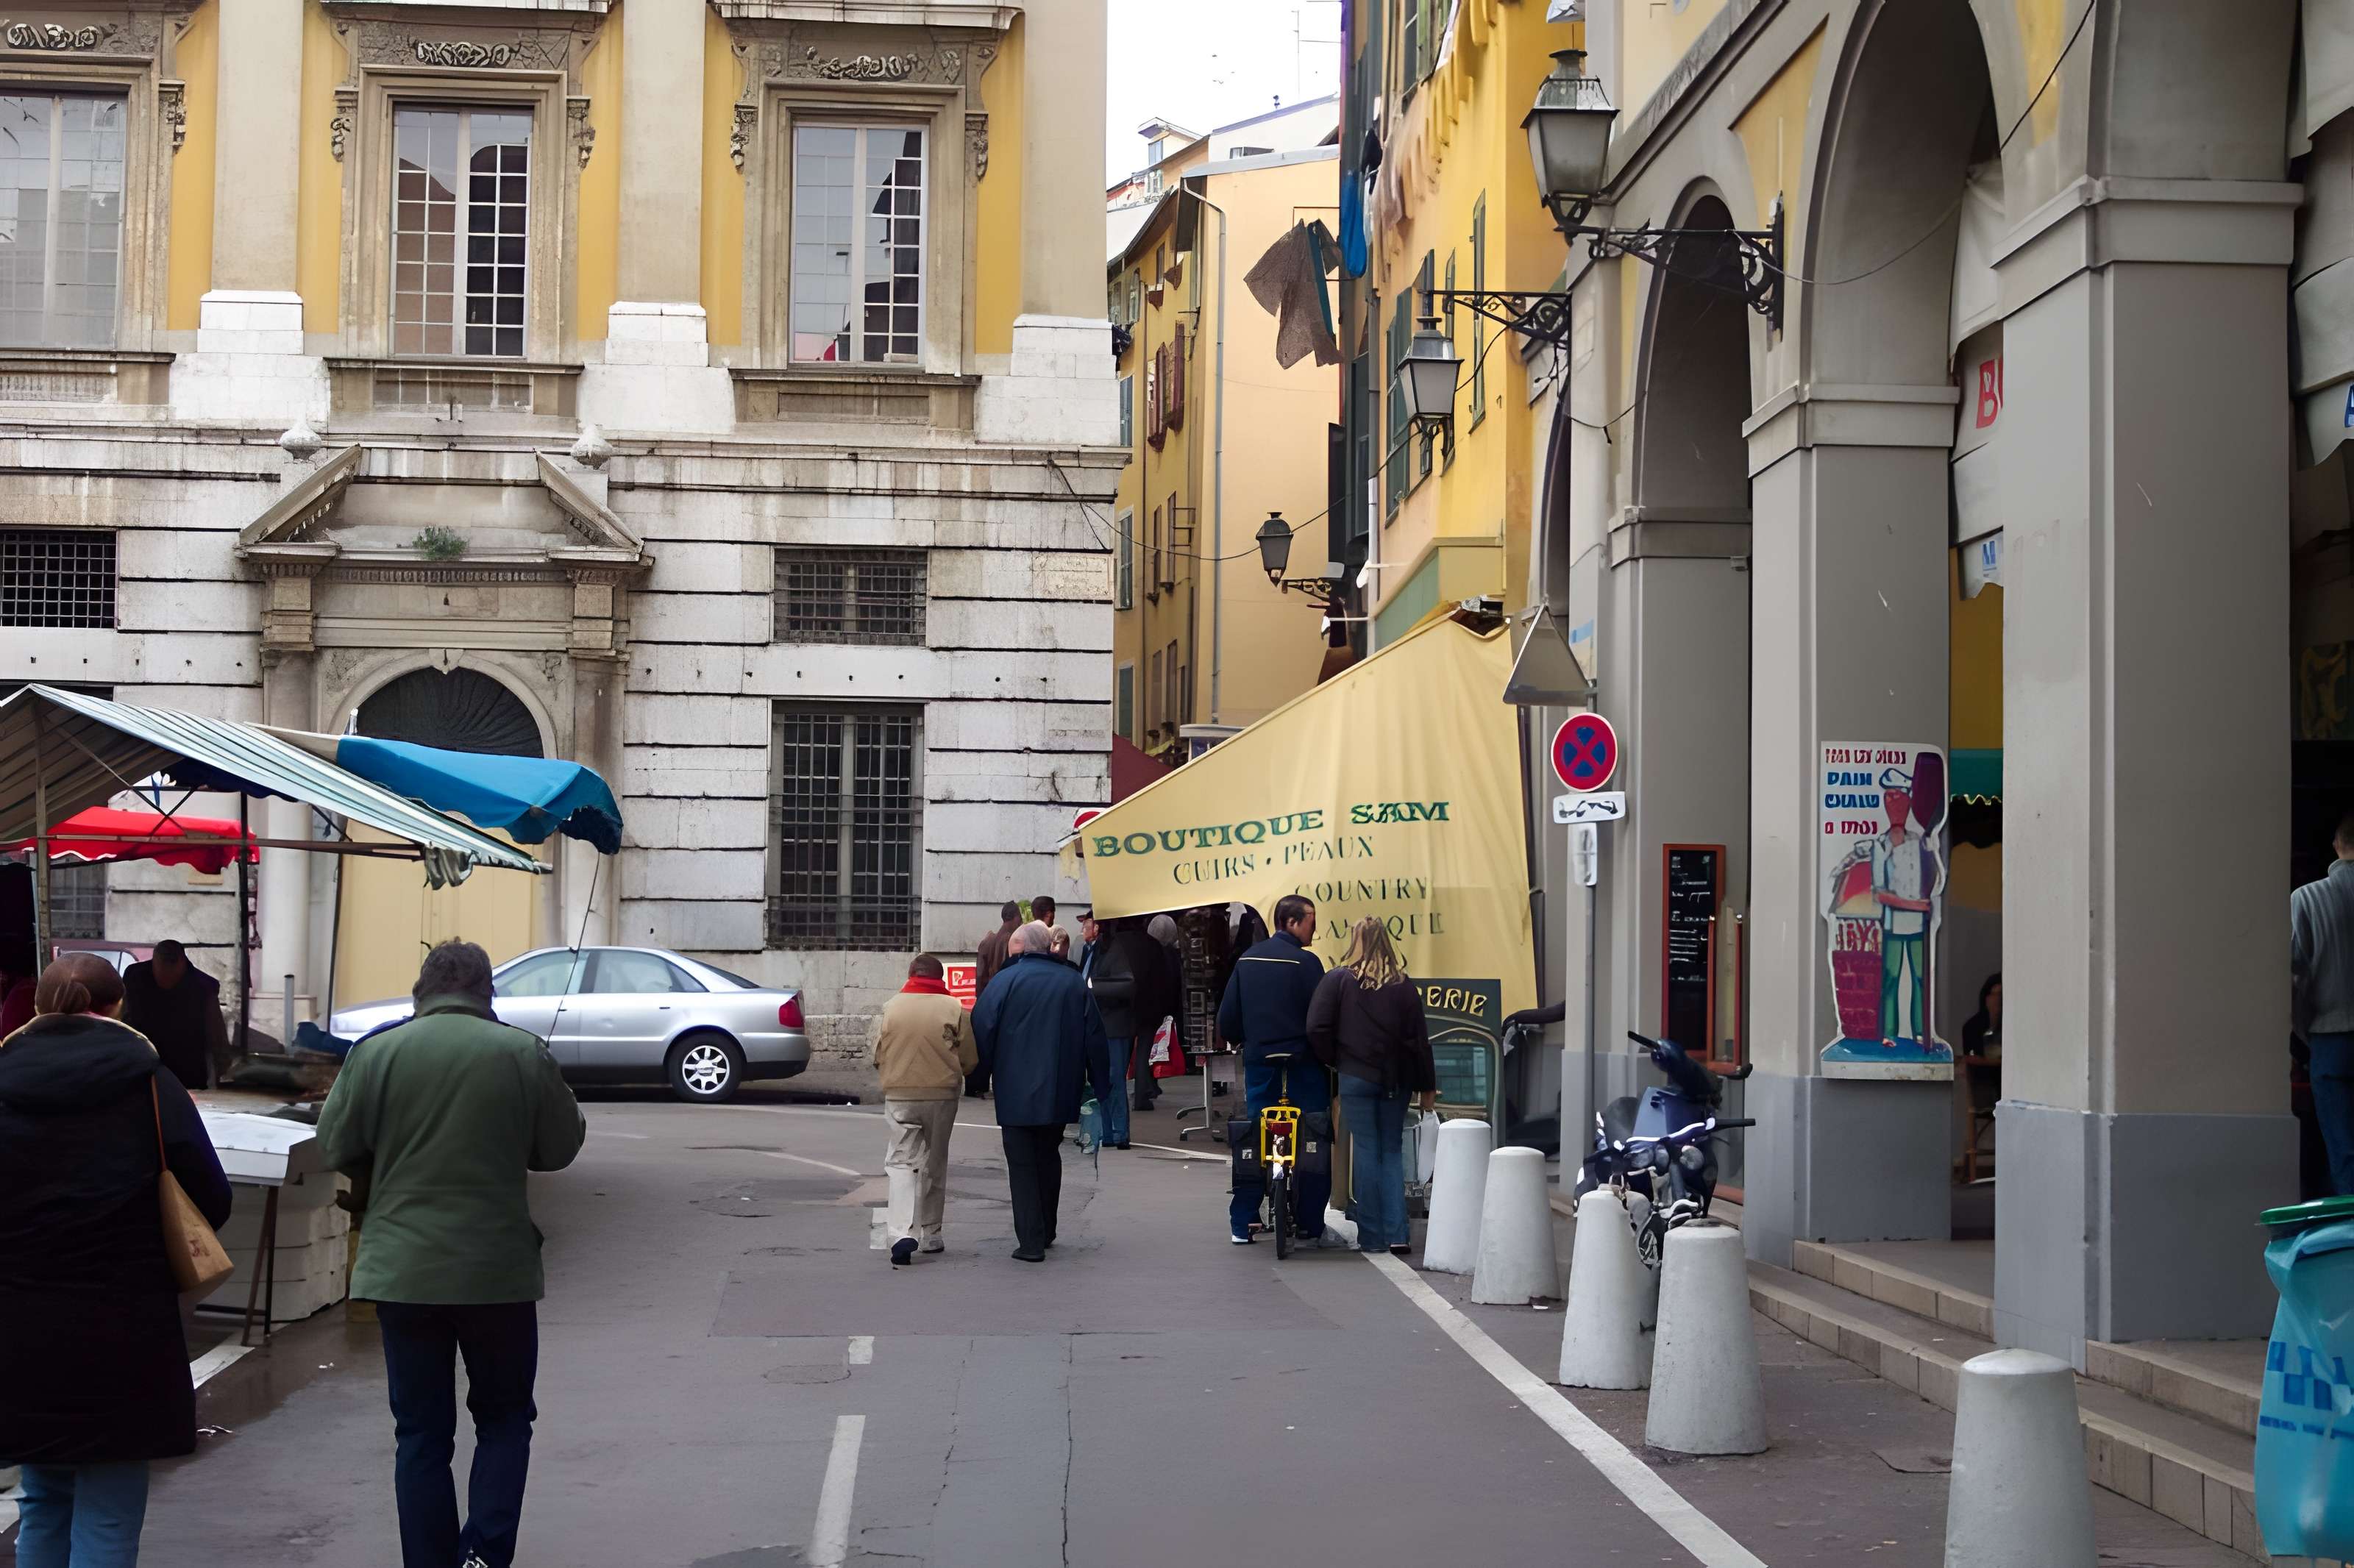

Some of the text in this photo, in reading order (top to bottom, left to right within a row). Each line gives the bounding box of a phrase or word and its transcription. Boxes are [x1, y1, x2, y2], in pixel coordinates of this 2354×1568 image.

[1093, 808, 1324, 858] BOUTIQUE
[1173, 835, 1374, 885] CUIRS PEAUX
